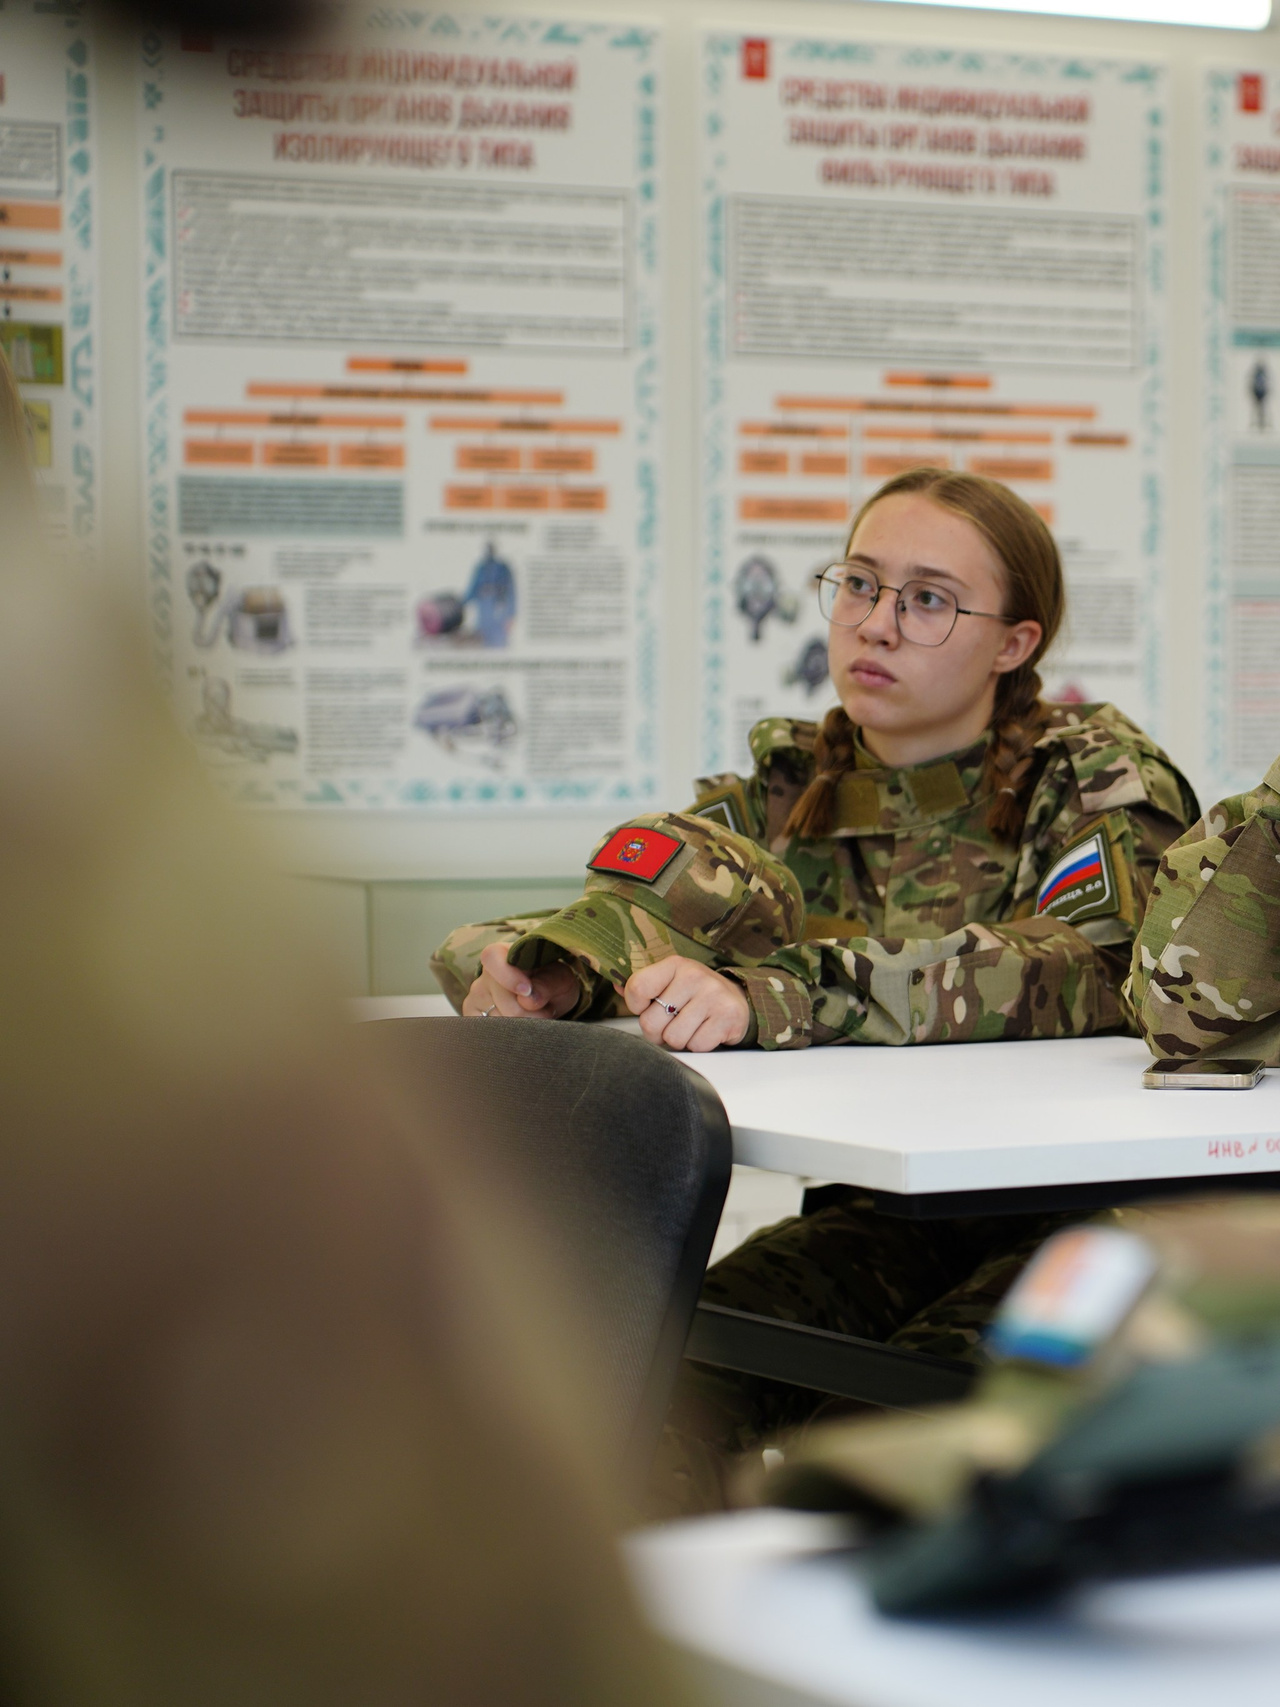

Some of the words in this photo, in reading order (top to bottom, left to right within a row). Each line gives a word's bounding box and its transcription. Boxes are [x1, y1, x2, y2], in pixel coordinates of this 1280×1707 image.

[357, 50, 579, 92] ИНДИВИДУАЛЬНОЙ
[233, 88, 340, 124] ЗАЩИТЫ
[345, 93, 452, 128] ОРГАНОВ
